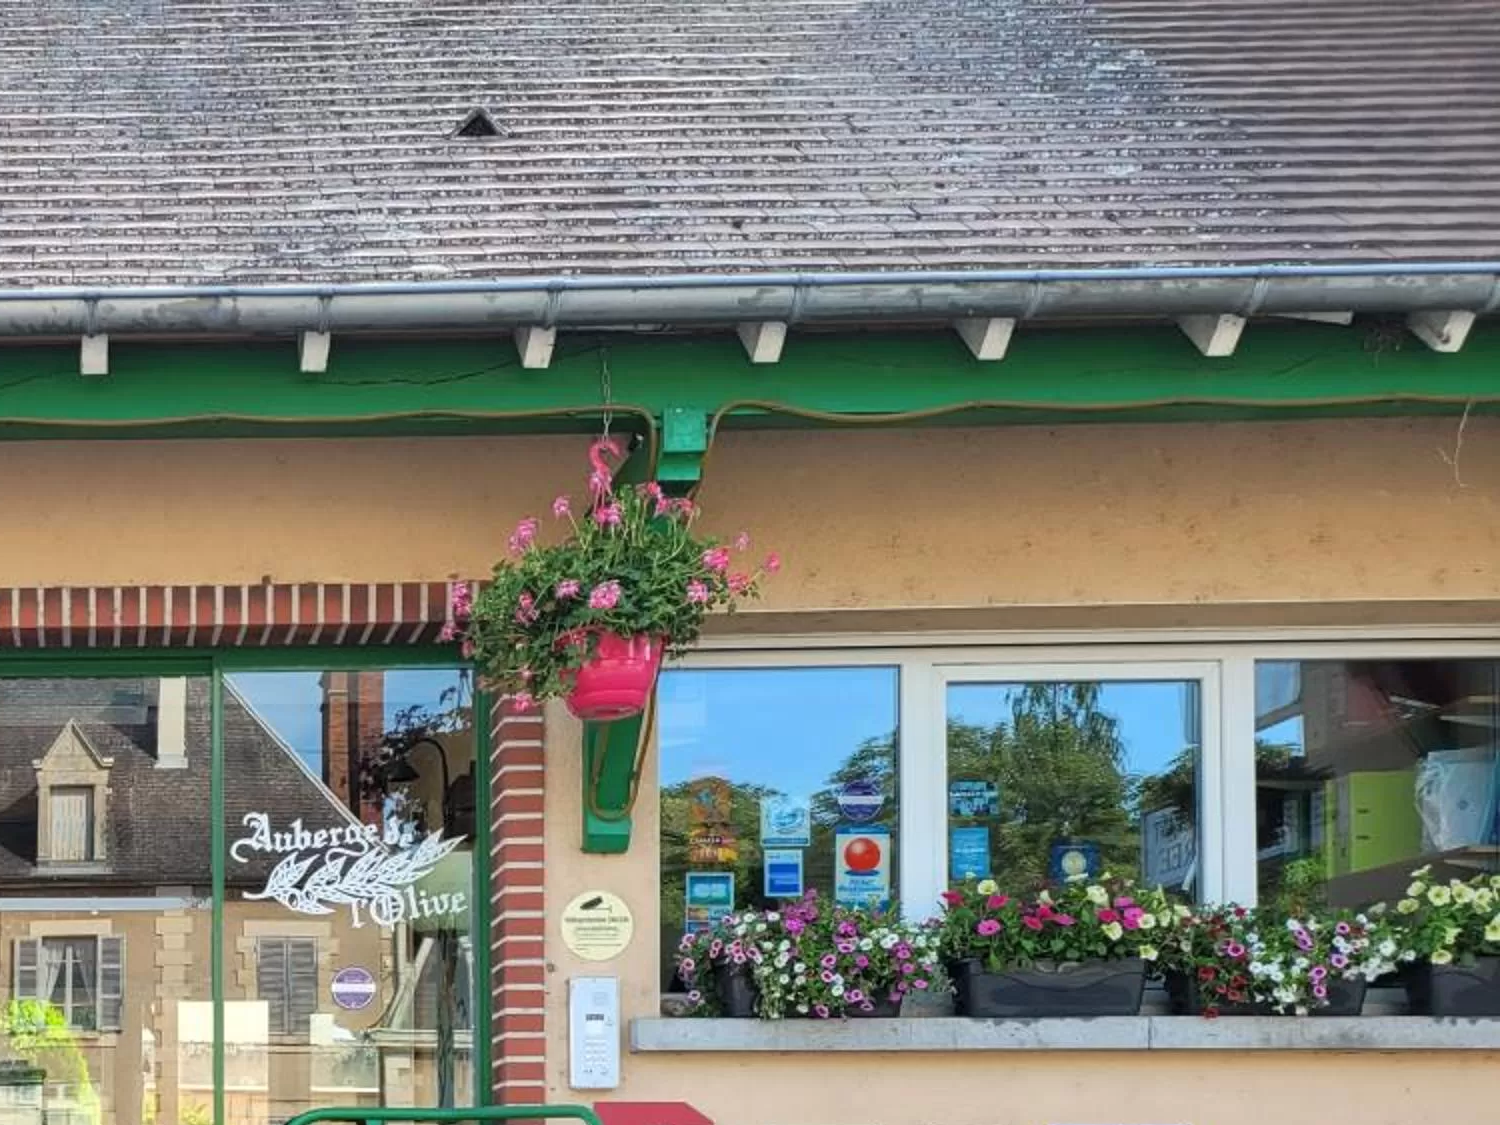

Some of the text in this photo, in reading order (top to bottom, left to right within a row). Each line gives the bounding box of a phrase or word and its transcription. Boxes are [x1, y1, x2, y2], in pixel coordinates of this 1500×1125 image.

[230, 811, 414, 863] Auberge de
[352, 885, 468, 930] l'Olive
